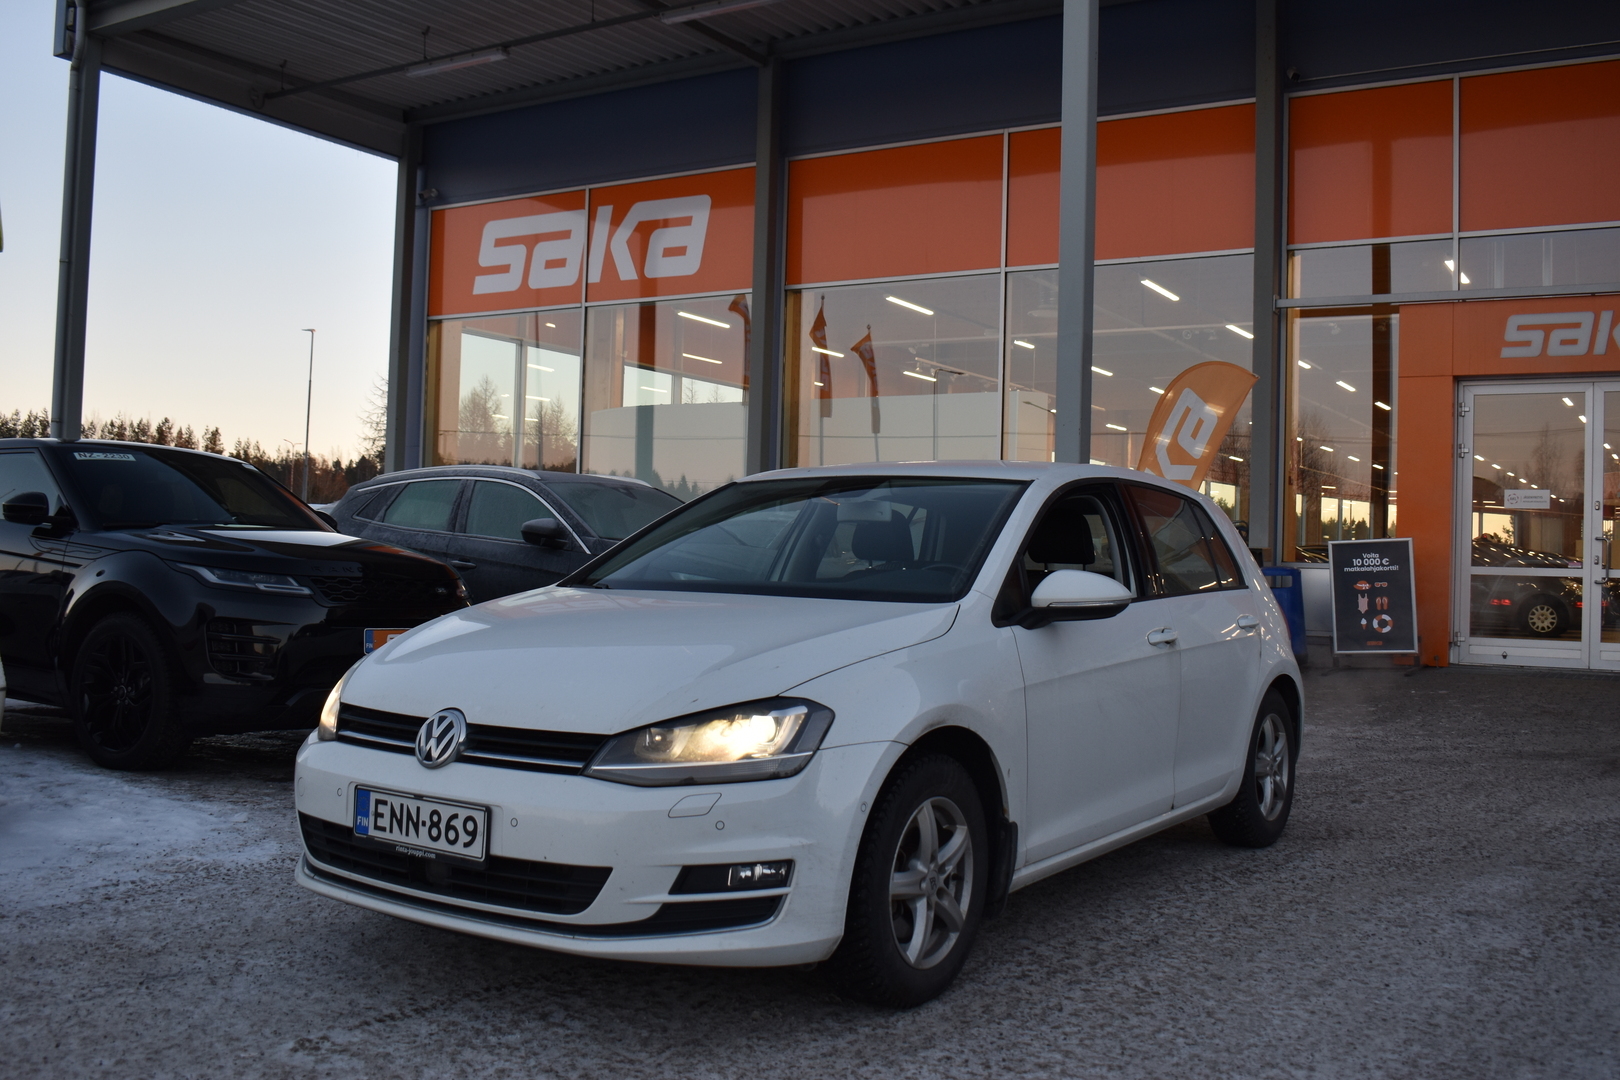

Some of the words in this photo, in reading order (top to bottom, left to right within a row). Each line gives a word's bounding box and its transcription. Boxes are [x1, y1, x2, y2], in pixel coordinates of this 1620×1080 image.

[1353, 558, 1362, 566] 10
[1363, 558, 1380, 566] 000
[1382, 558, 1390, 566] €
[1344, 564, 1399, 572] matkalahjakortti!
[357, 815, 369, 827] FIN
[374, 798, 478, 848] ENN-869
[395, 845, 436, 859] rinta-jouppi.com
